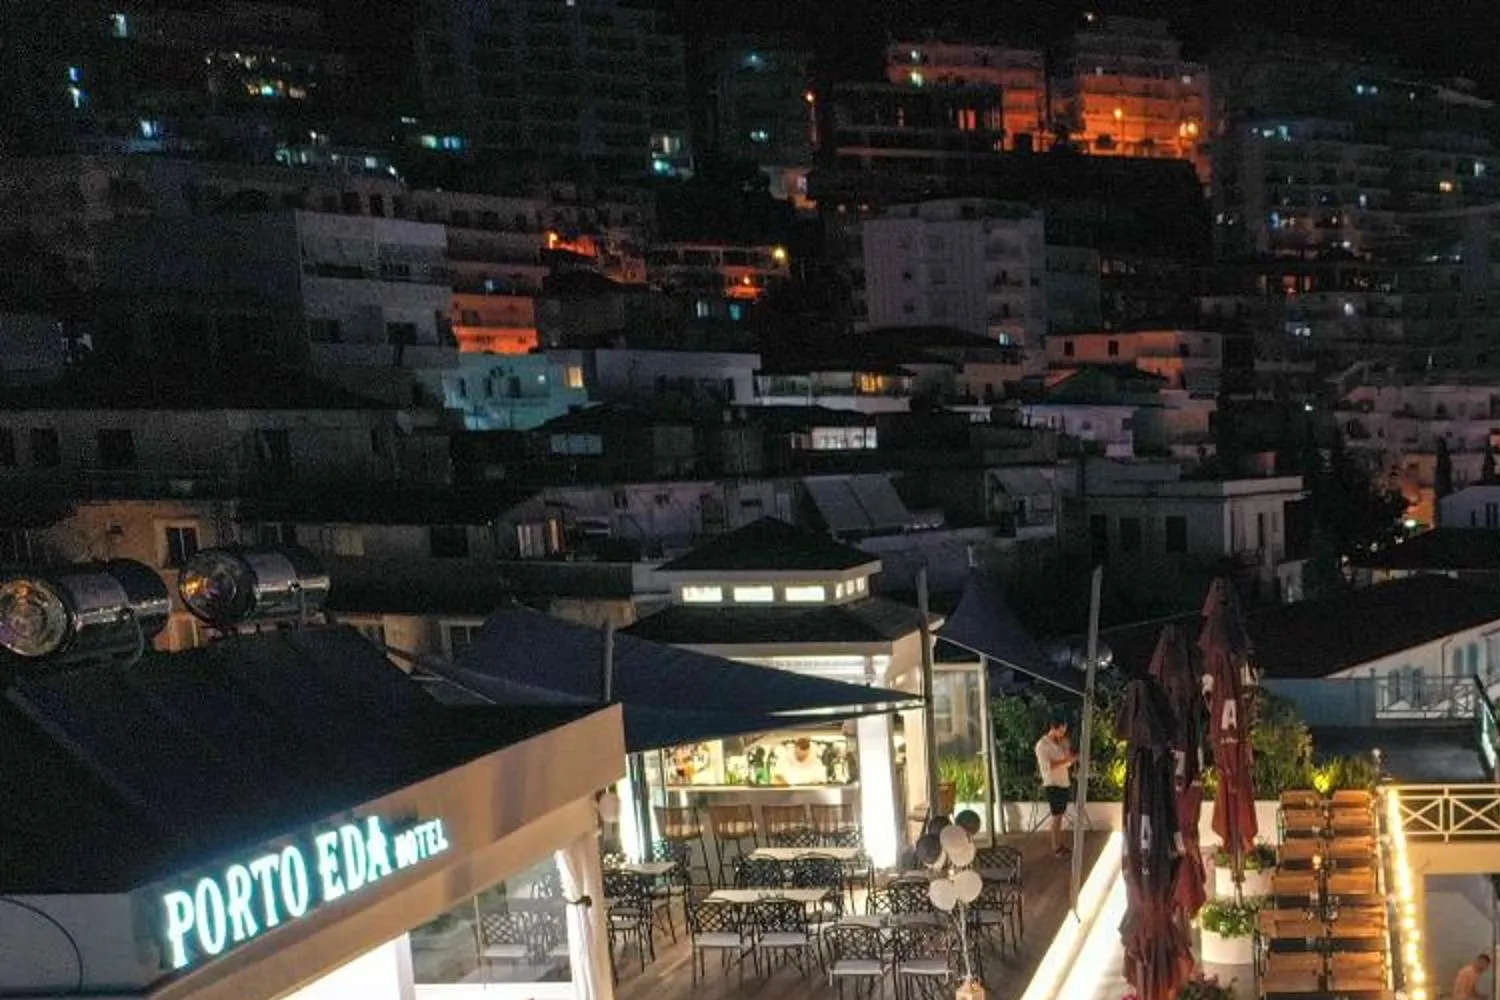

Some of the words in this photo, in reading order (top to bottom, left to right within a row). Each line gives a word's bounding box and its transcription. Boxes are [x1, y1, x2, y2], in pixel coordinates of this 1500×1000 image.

[163, 845, 309, 969] PORTO
[315, 815, 393, 902] EDA
[393, 818, 449, 869] HOTEL
